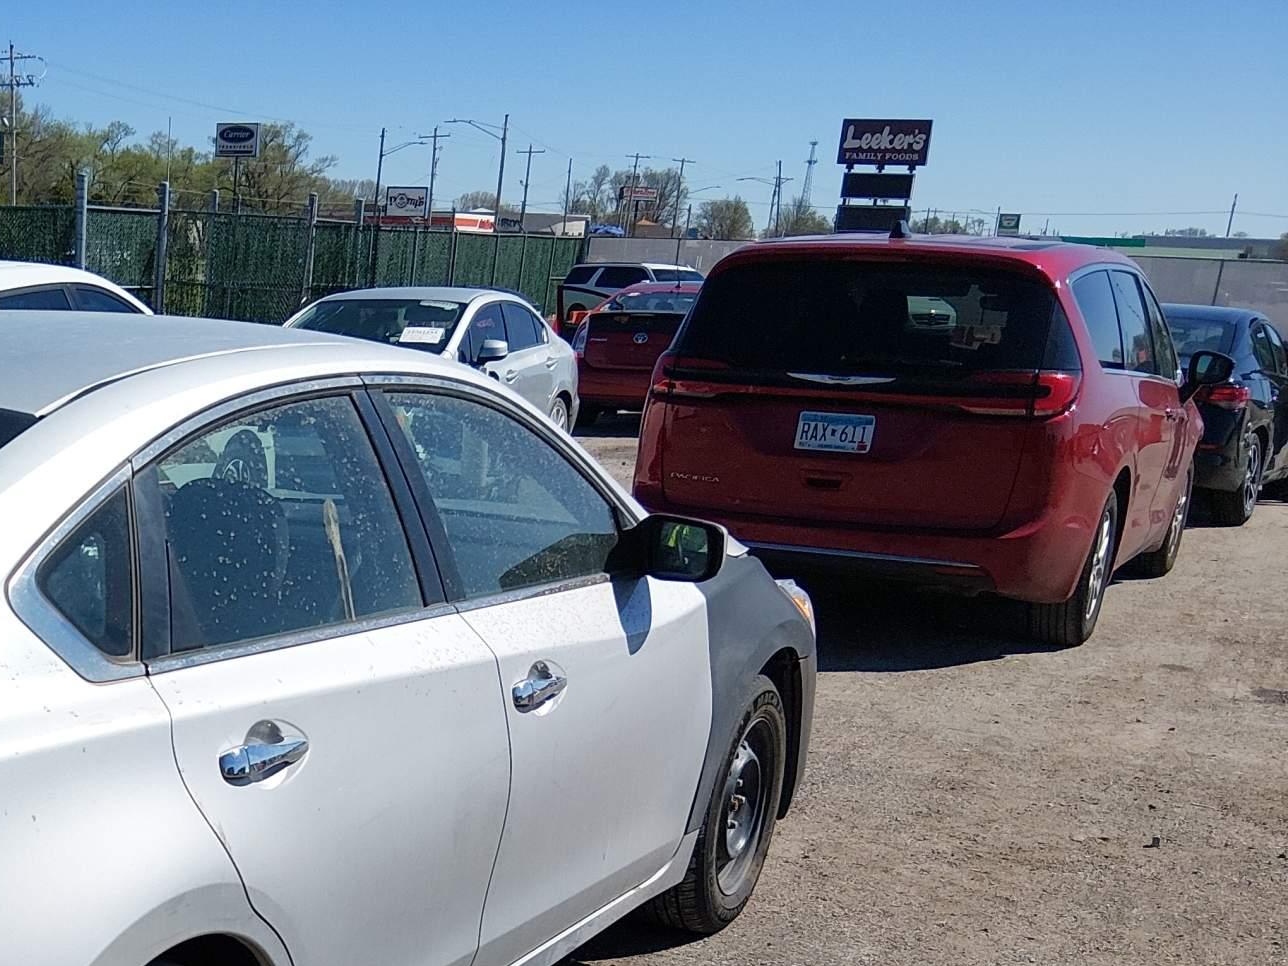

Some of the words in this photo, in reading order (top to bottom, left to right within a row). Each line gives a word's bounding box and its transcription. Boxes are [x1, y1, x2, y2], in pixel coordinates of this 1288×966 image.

[223, 129, 251, 139] Carrier
[843, 125, 927, 151] Leeker's
[845, 152, 882, 160] FAMILY
[885, 152, 919, 161] FOODS
